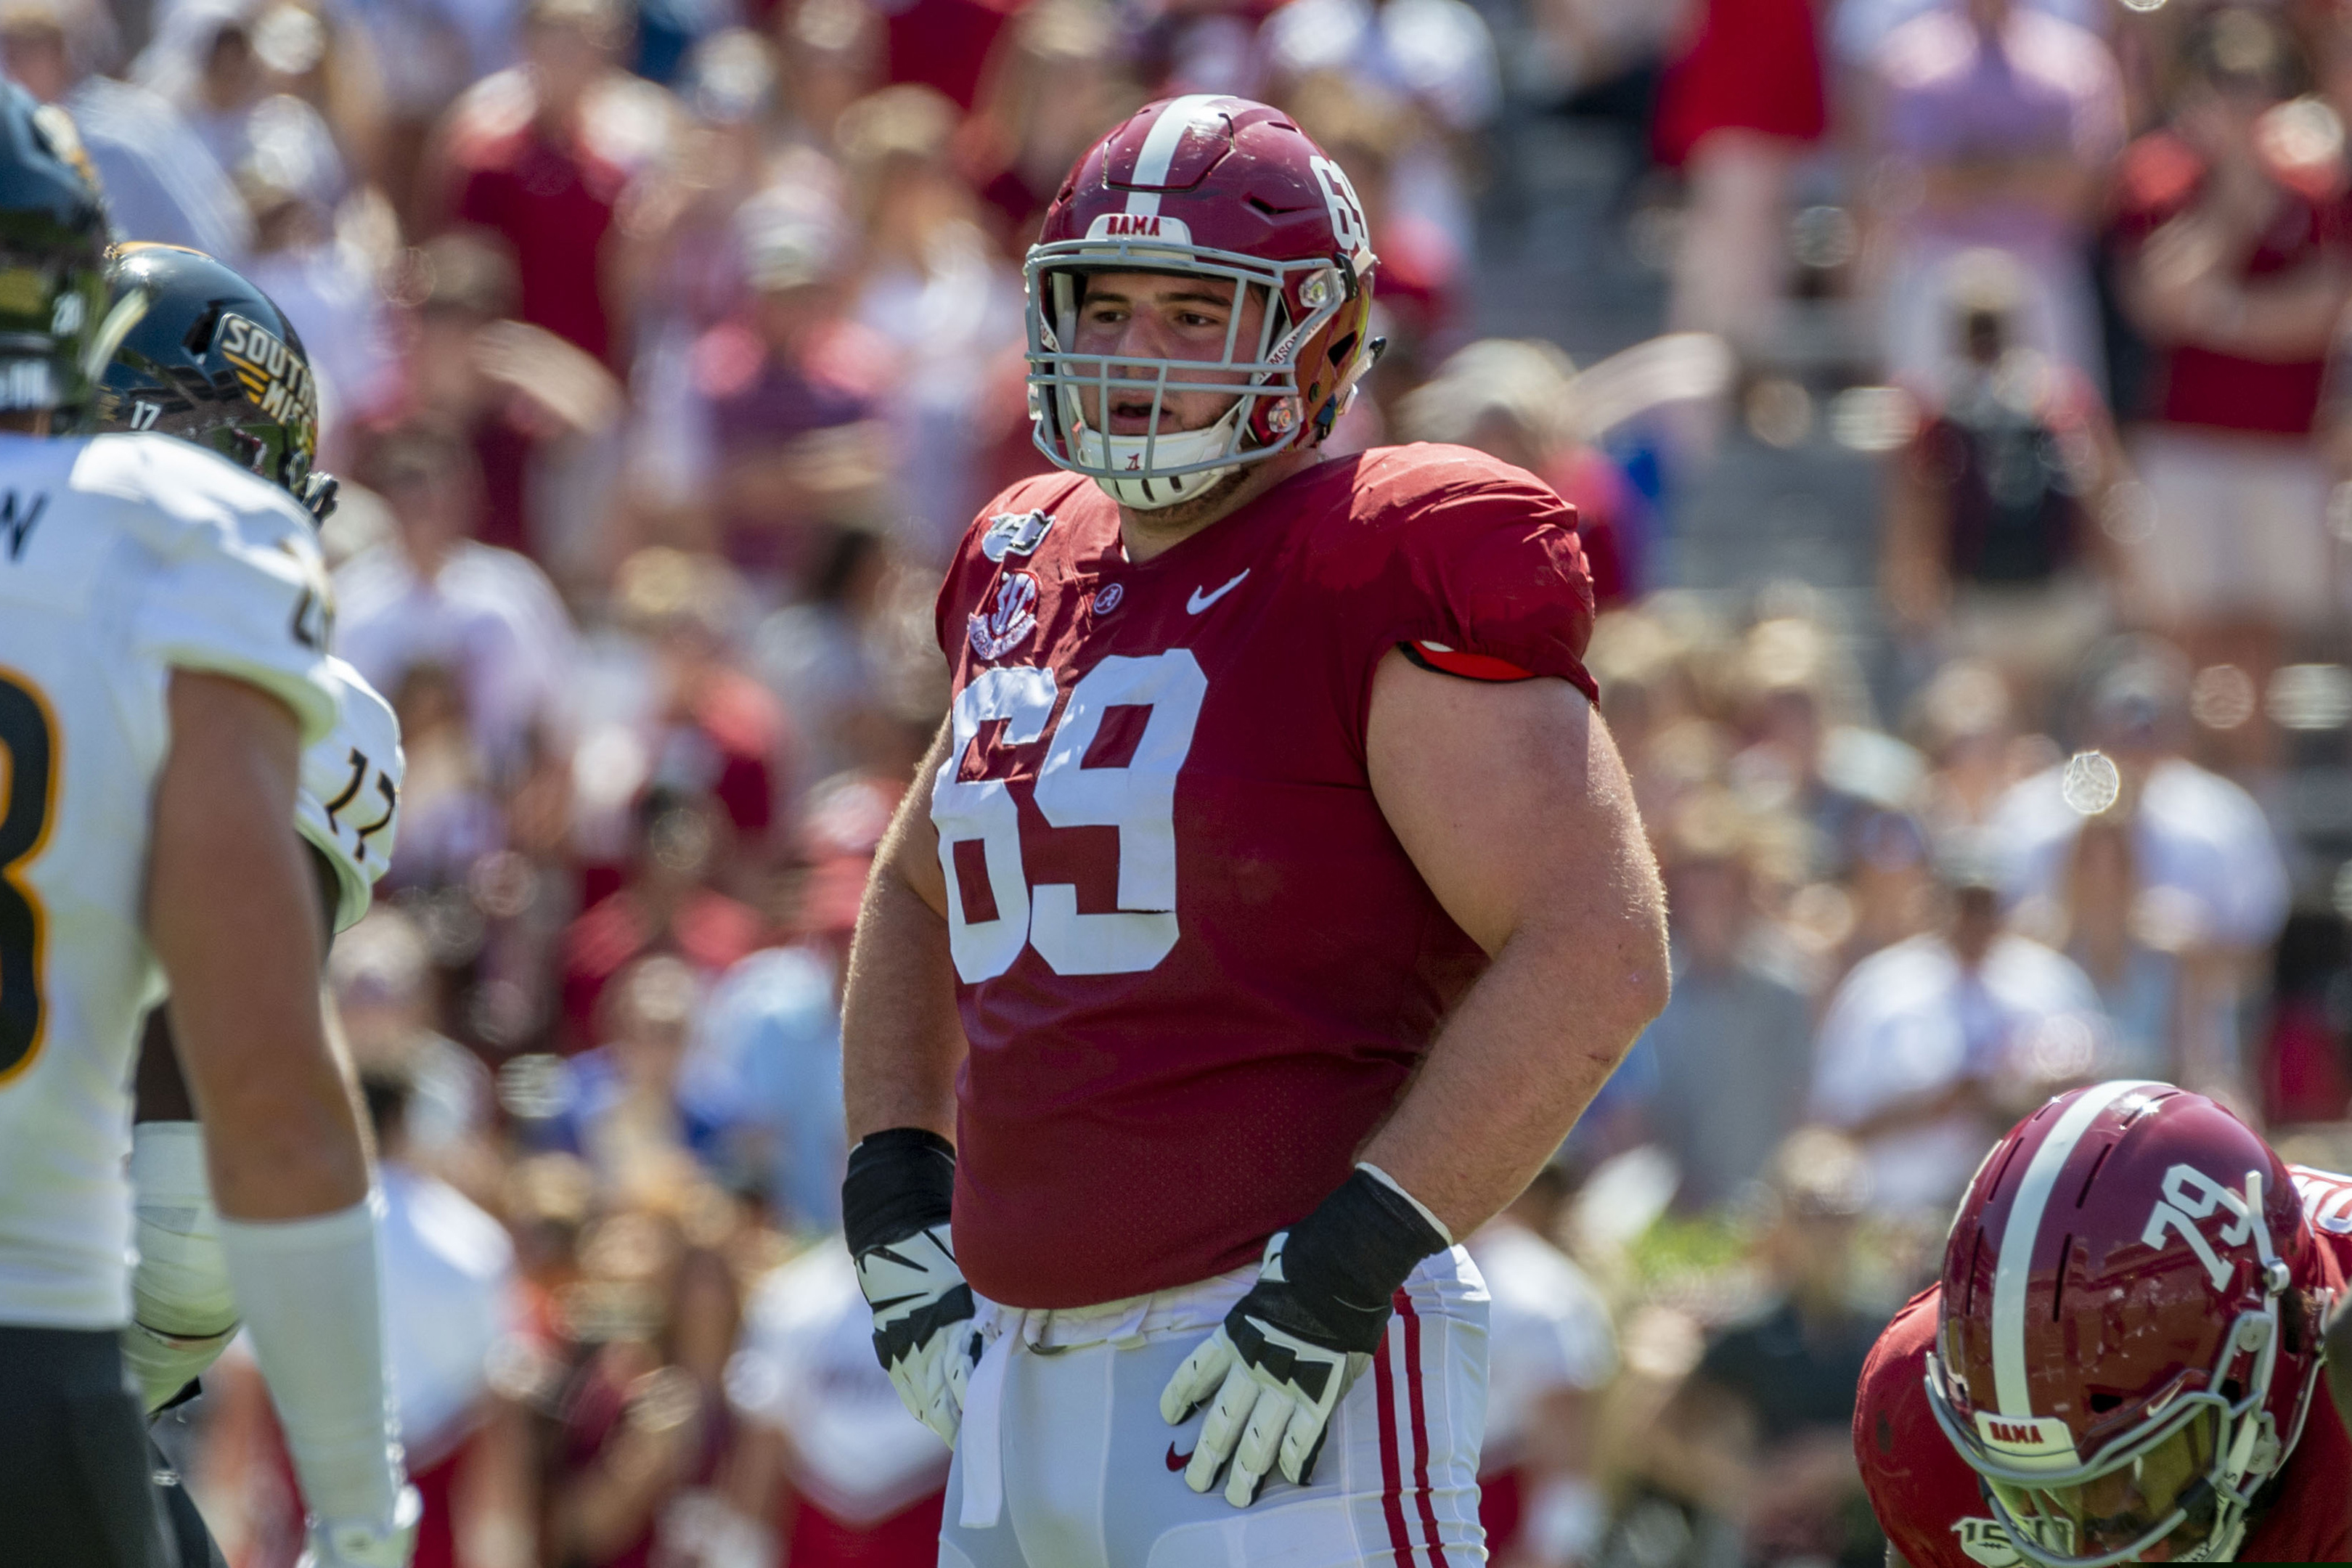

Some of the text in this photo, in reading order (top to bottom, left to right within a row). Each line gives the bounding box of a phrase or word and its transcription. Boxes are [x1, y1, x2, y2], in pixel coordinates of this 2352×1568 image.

[1106, 215, 1160, 237] BAMA
[1310, 155, 1371, 253] 69
[129, 400, 161, 431] 17
[930, 648, 1209, 984] 69
[2141, 1163, 2251, 1293] 79
[1988, 1421, 2044, 1444] BAMA
